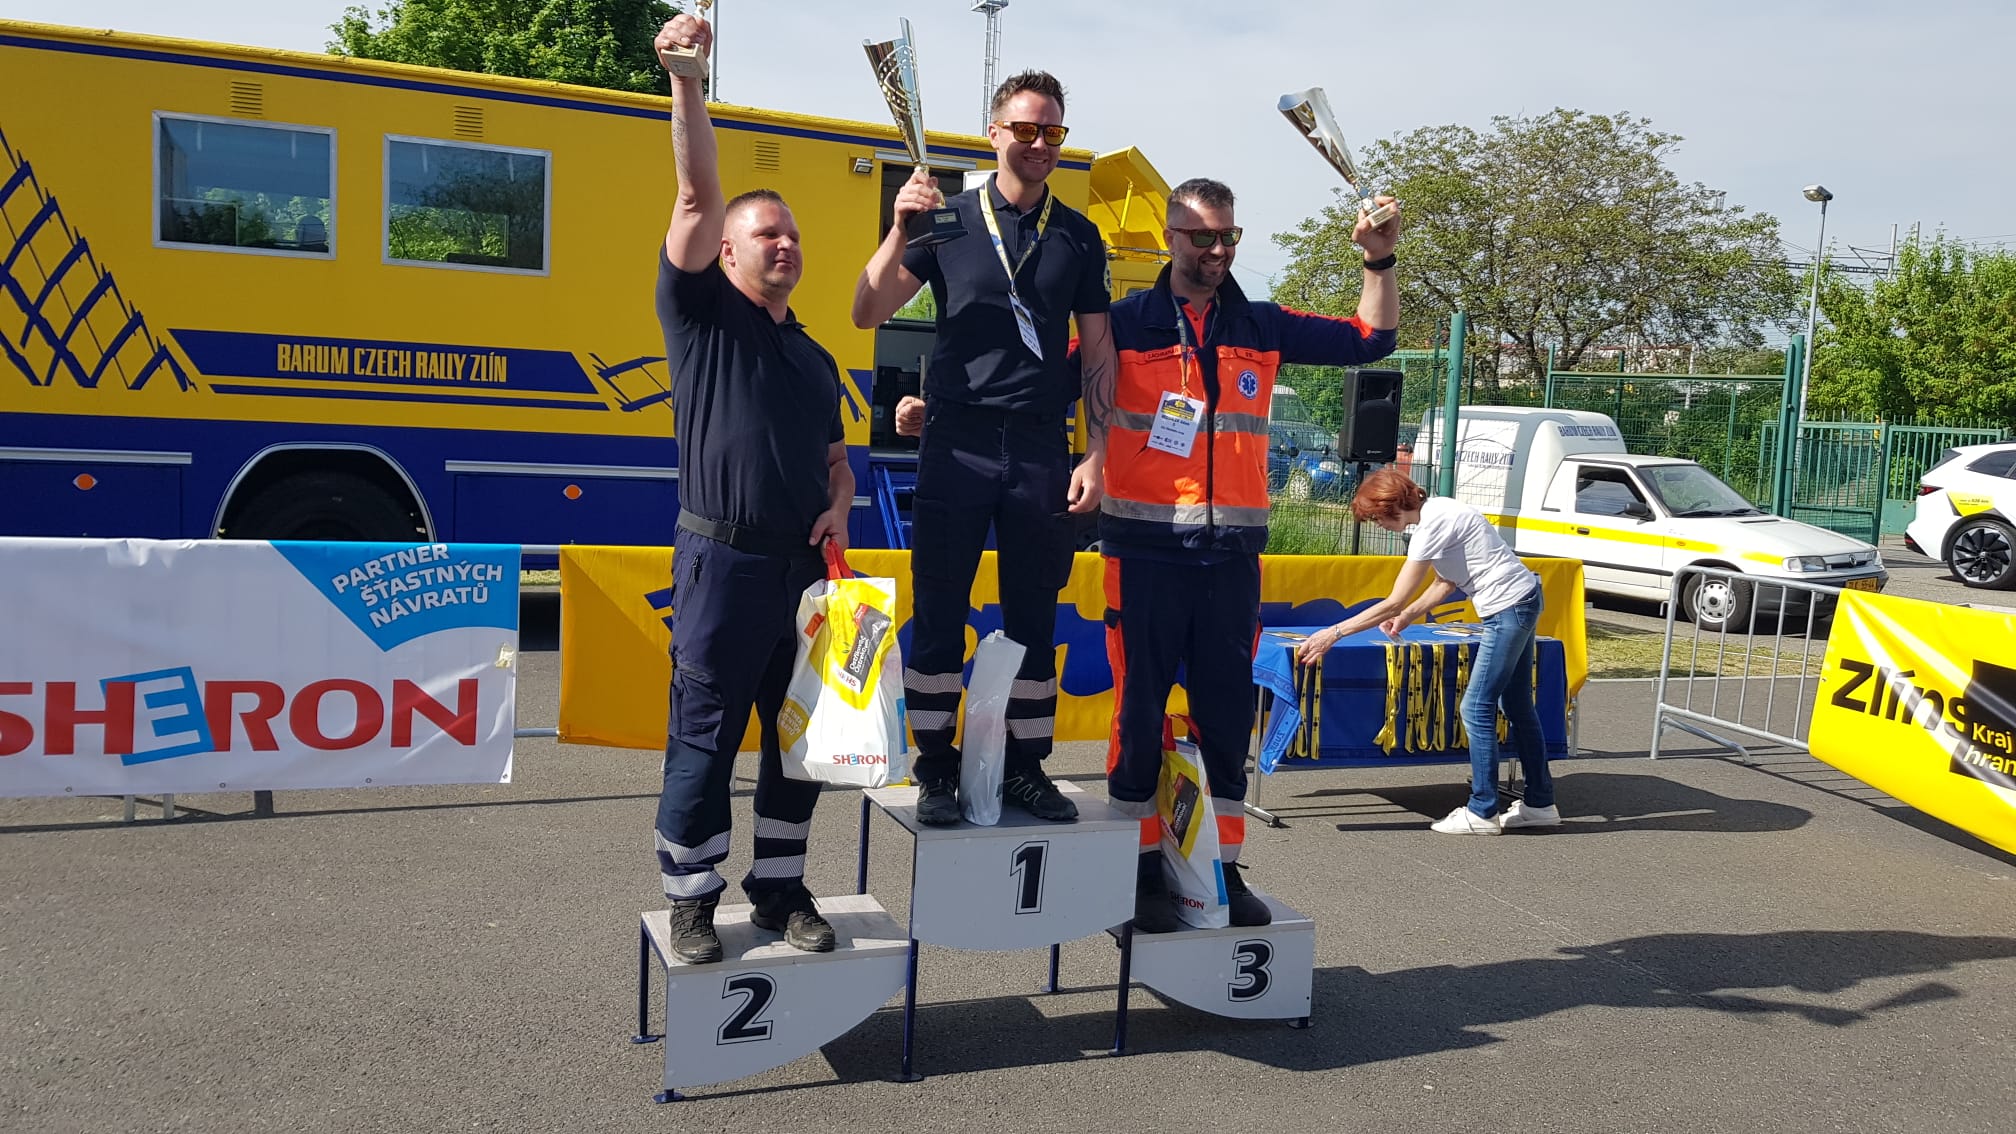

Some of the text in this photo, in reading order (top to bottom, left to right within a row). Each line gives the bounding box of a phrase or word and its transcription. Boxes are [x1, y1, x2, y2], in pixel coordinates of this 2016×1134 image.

[277, 343, 507, 382] BARUM CZECH RALLY ZLÍN
[331, 543, 450, 594] PARTNER
[360, 560, 503, 607] ŠŤASTNÝCH
[368, 582, 489, 629] NÁVRATŮ
[832, 753, 887, 766] SHERON
[1972, 721, 2013, 754] Kraj
[1010, 840, 1049, 915] 1
[1227, 939, 1275, 1002] 3
[716, 971, 778, 1046] 2
